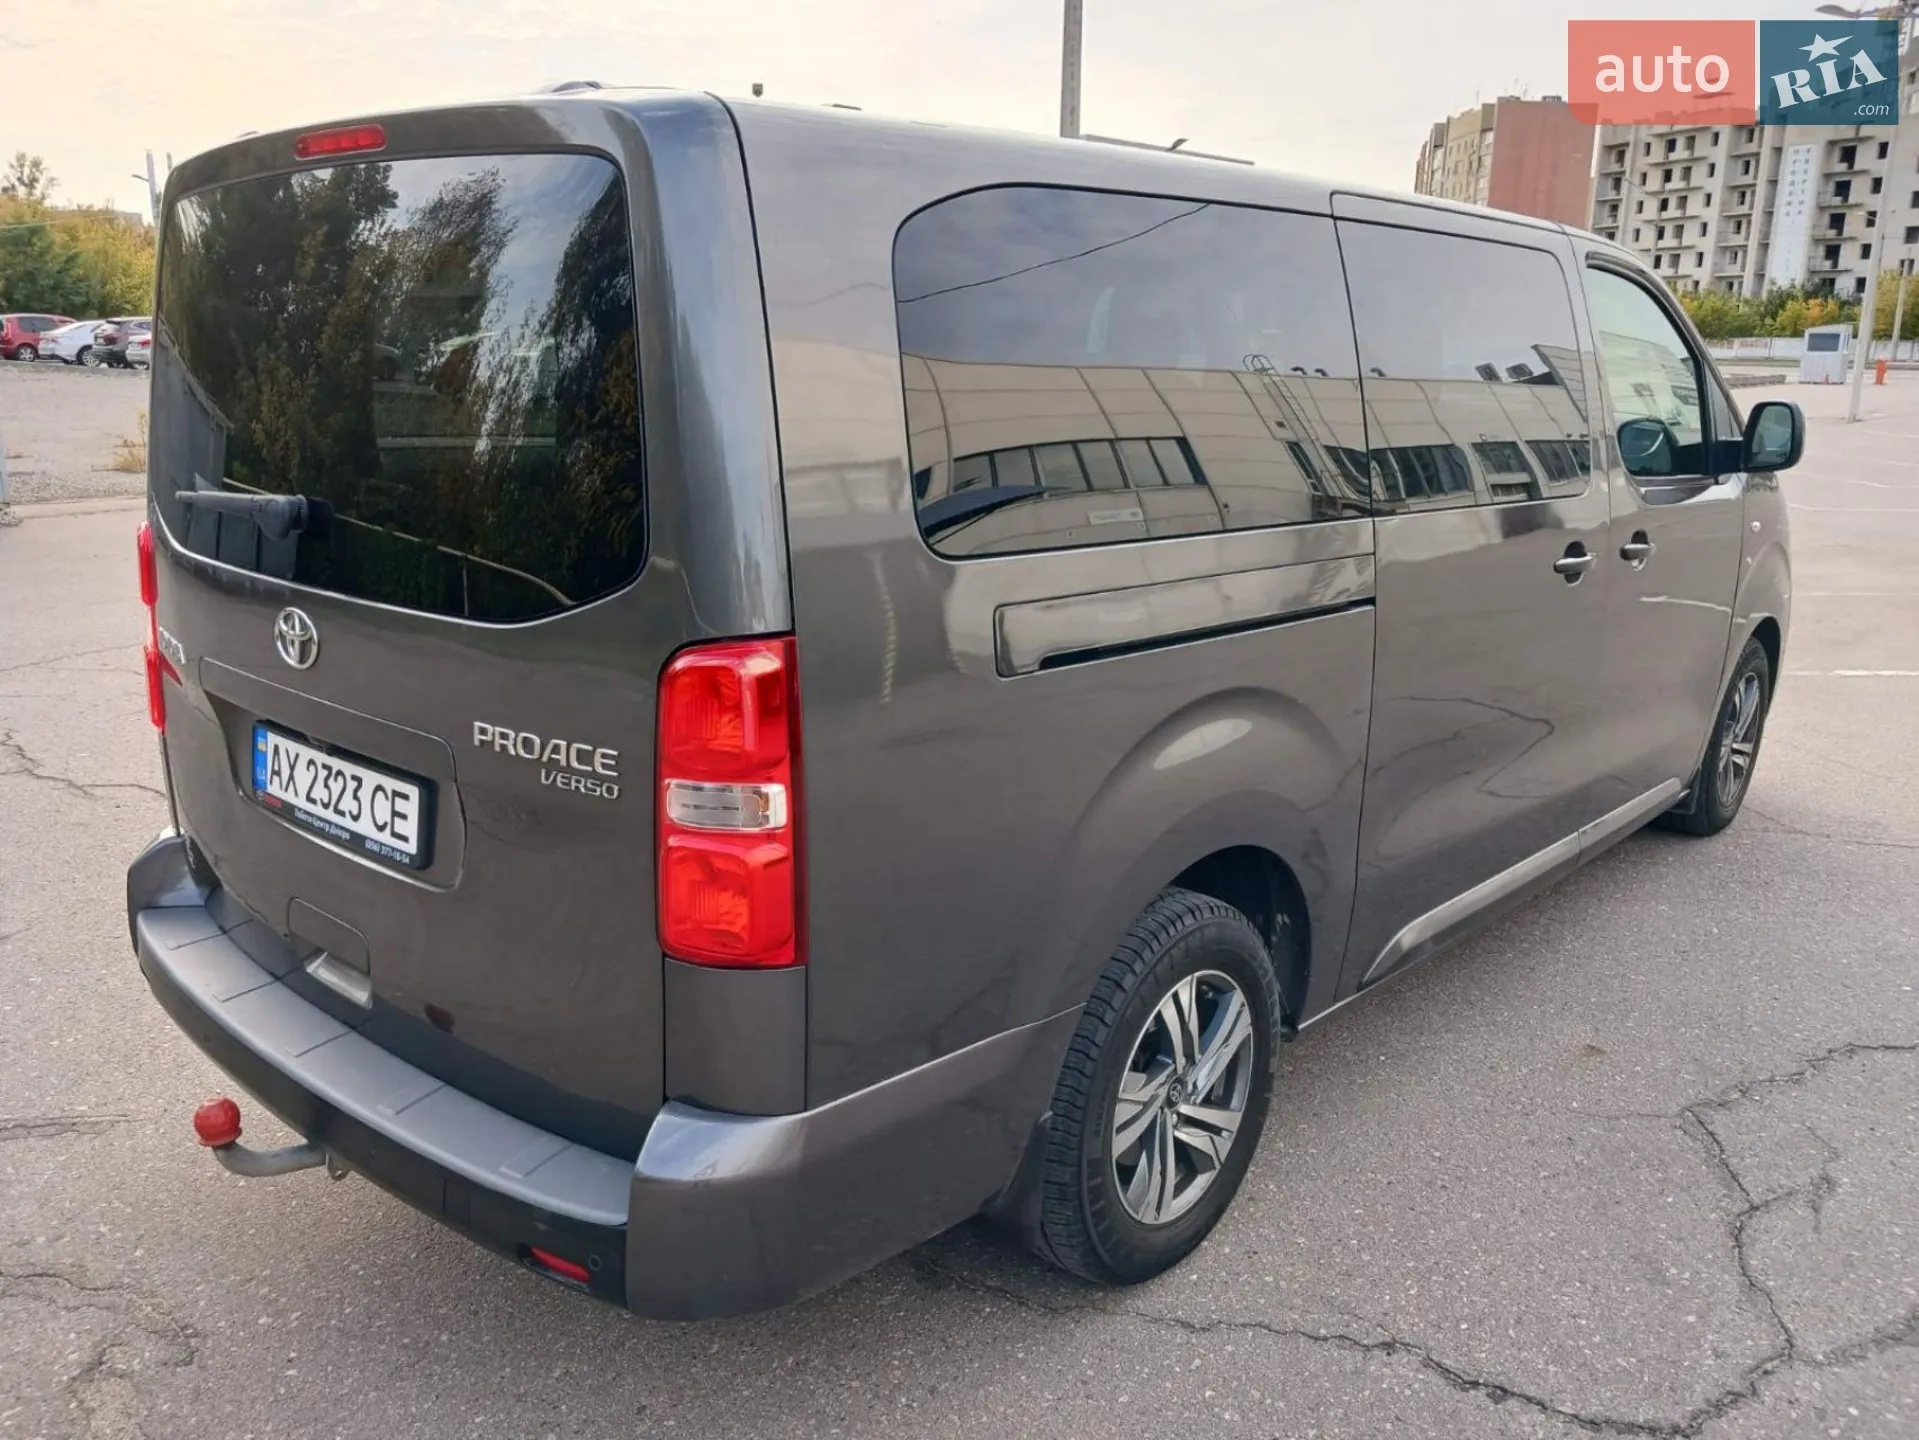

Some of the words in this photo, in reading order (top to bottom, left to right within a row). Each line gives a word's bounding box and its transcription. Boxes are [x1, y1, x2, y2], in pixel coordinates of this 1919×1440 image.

[473, 721, 619, 776] PROACE
[269, 743, 299, 798] AX
[305, 758, 363, 822] 2323
[370, 783, 411, 844] CE
[541, 768, 619, 799] VERSO
